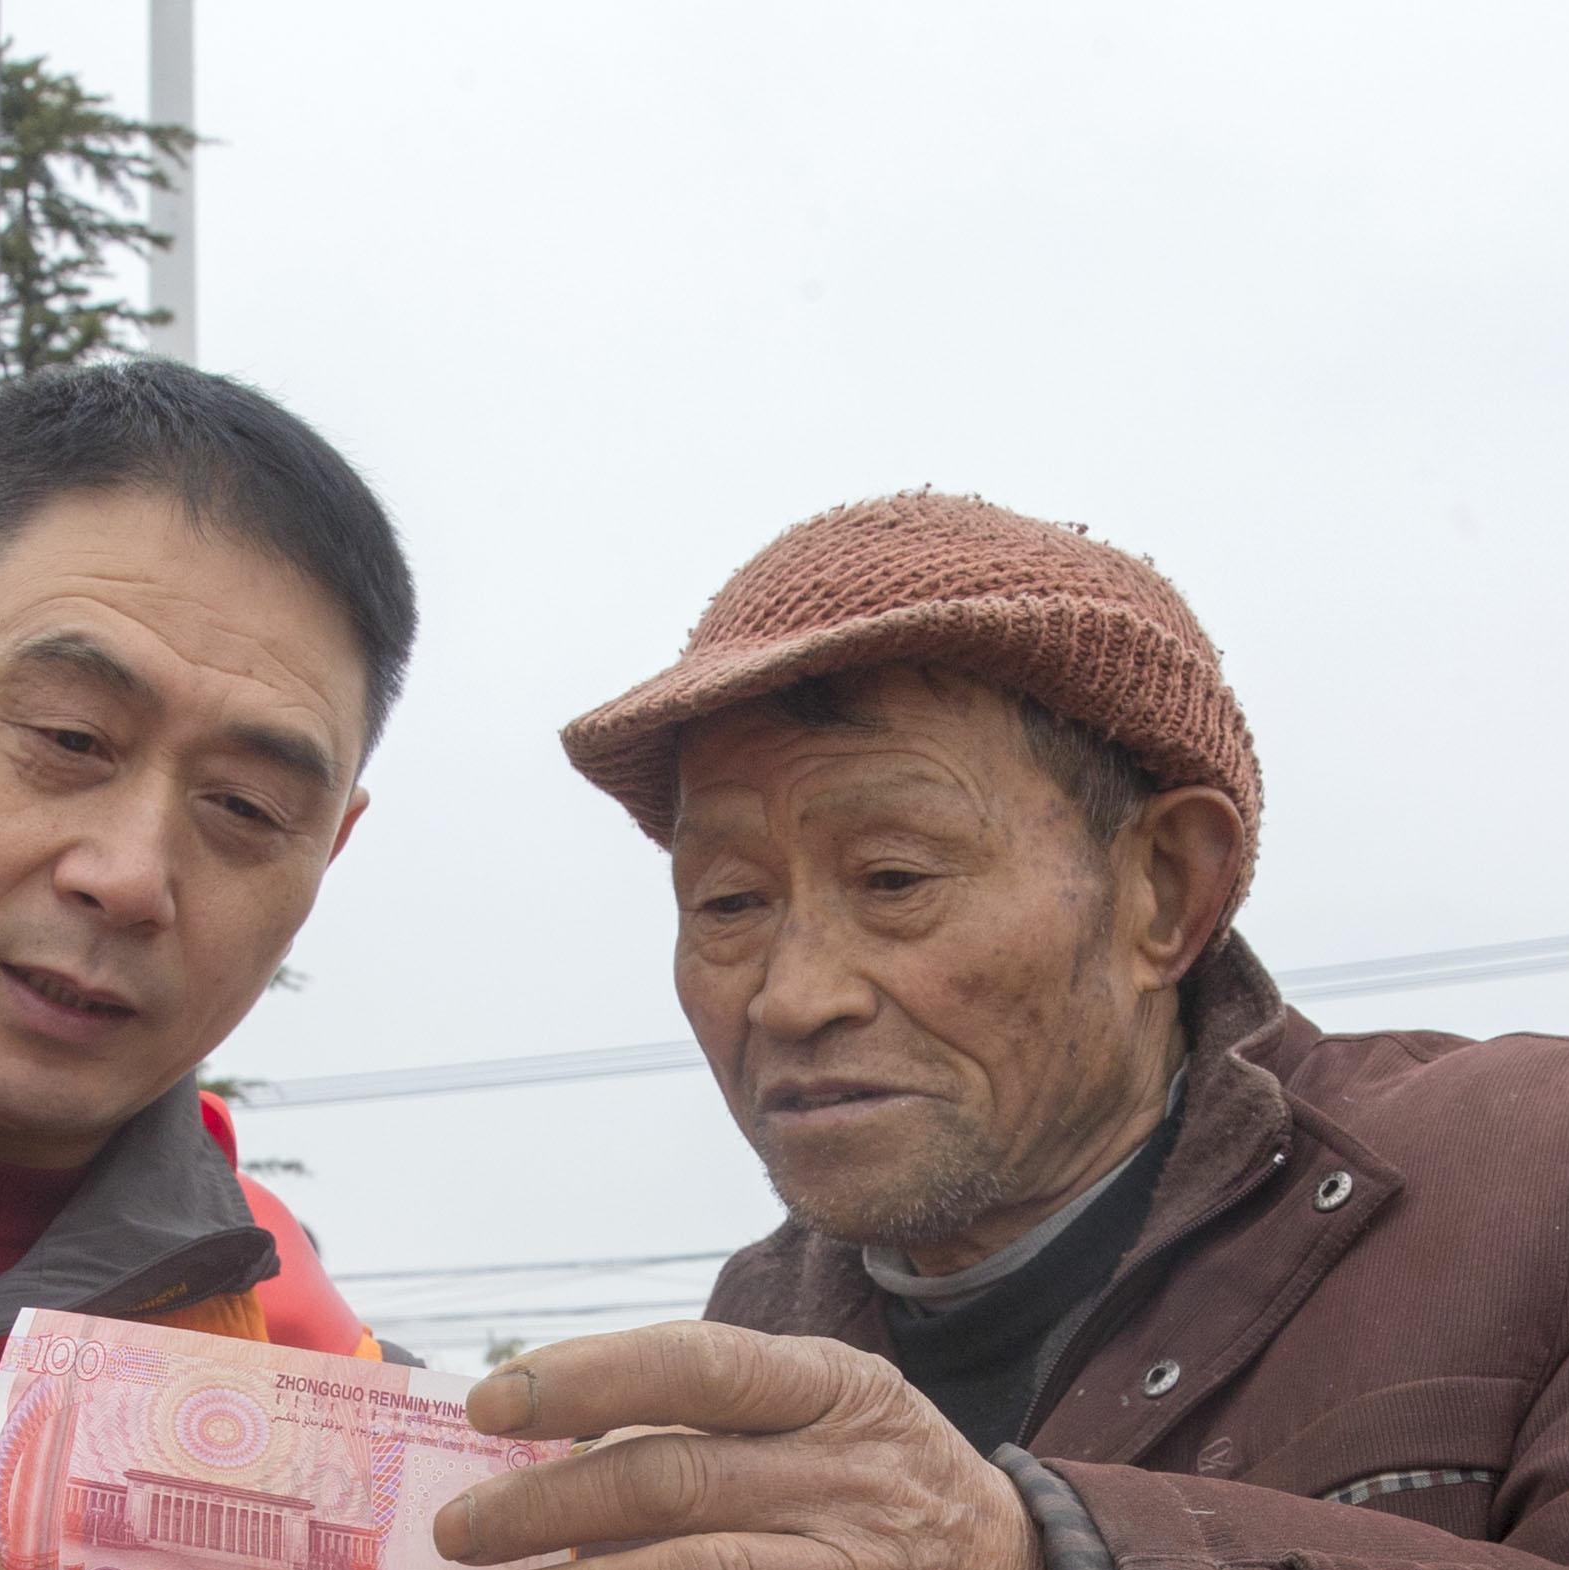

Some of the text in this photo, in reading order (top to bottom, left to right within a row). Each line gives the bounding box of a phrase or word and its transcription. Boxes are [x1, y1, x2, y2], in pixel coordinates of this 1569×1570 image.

[27, 1332, 106, 1382] 100
[275, 1373, 365, 1402] ZHONGGUO
[368, 1388, 430, 1413] RENMIN
